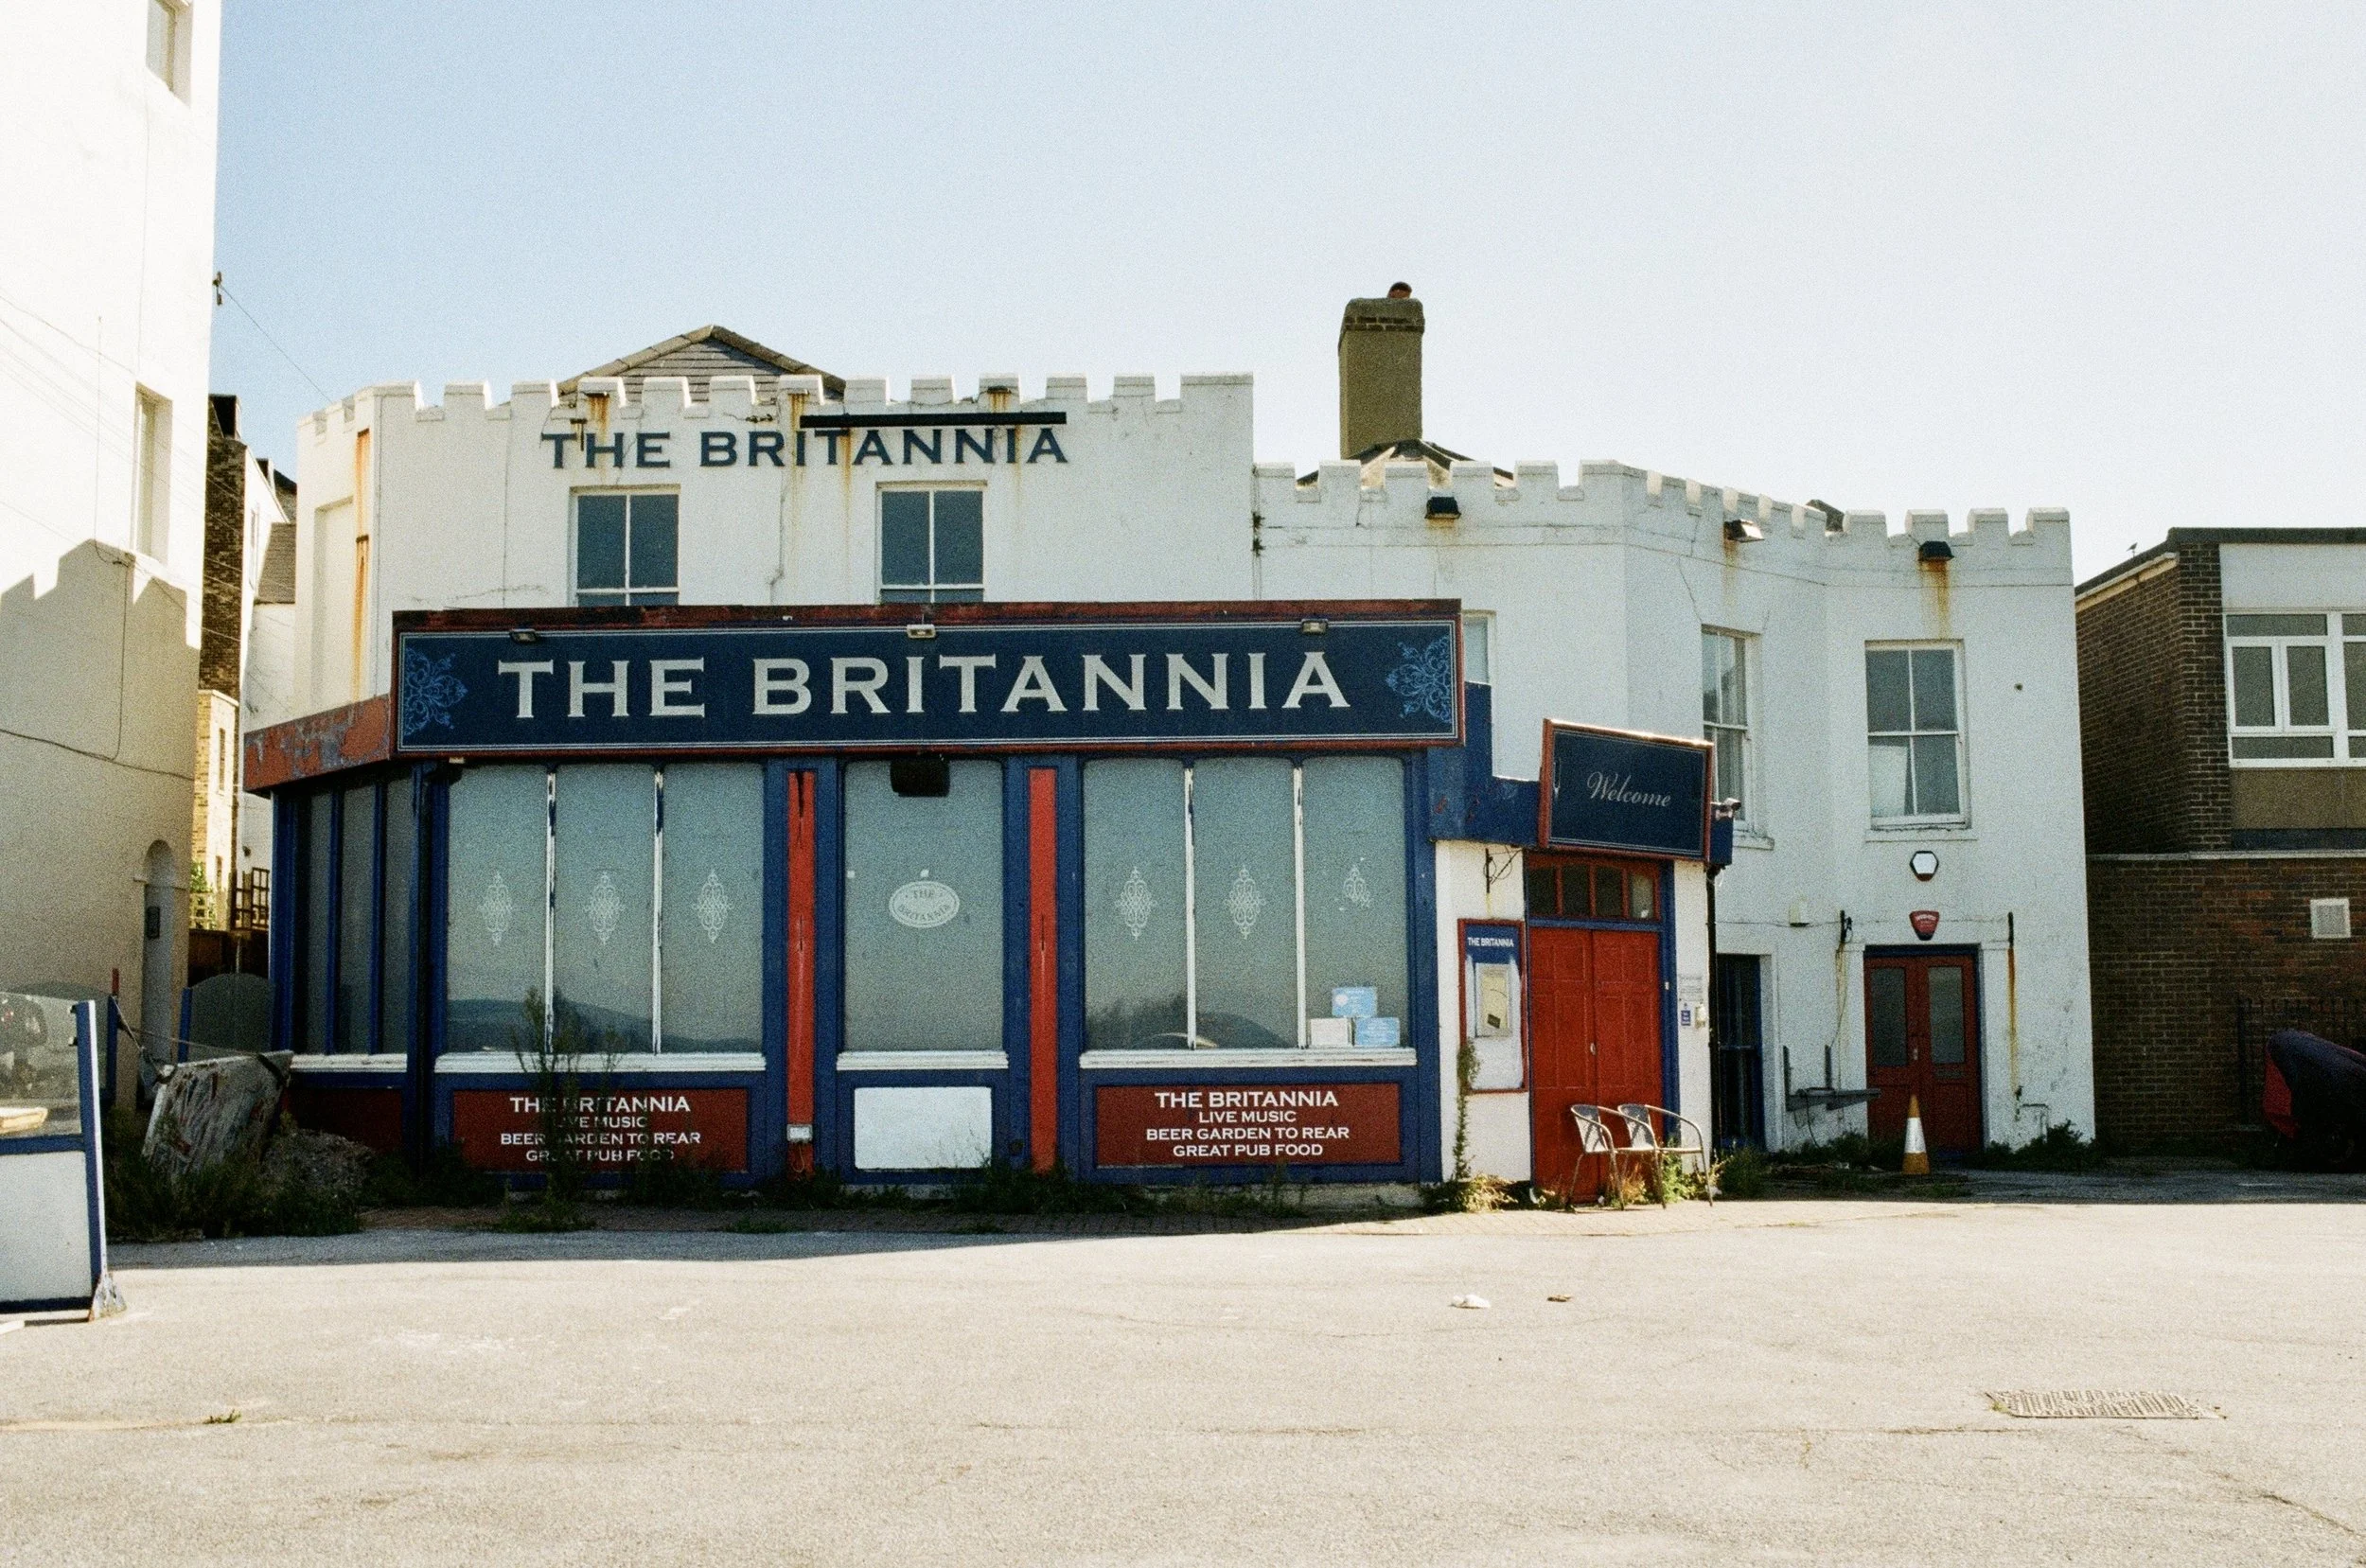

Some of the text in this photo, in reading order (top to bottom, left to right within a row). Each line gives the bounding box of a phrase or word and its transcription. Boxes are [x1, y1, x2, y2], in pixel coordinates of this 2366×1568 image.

[541, 428, 1068, 470] THE BRITANNIA
[498, 651, 1351, 718] THE BRITANNIA
[1586, 771, 1671, 807] Welcome
[1467, 937, 1514, 947] THE BRITANNIA
[1154, 1090, 1339, 1108] THE BRITANNIA
[554, 1116, 590, 1128] VE
[1199, 1110, 1297, 1123] LIVE MUSIC
[501, 1132, 701, 1145] BEER ARDEN TO REAR
[1146, 1126, 1350, 1141] BEER GARDEN TO REAR
[526, 1150, 580, 1162] GRT
[587, 1150, 623, 1162] PUB
[1173, 1143, 1323, 1157] GREAT PUB FOOD
